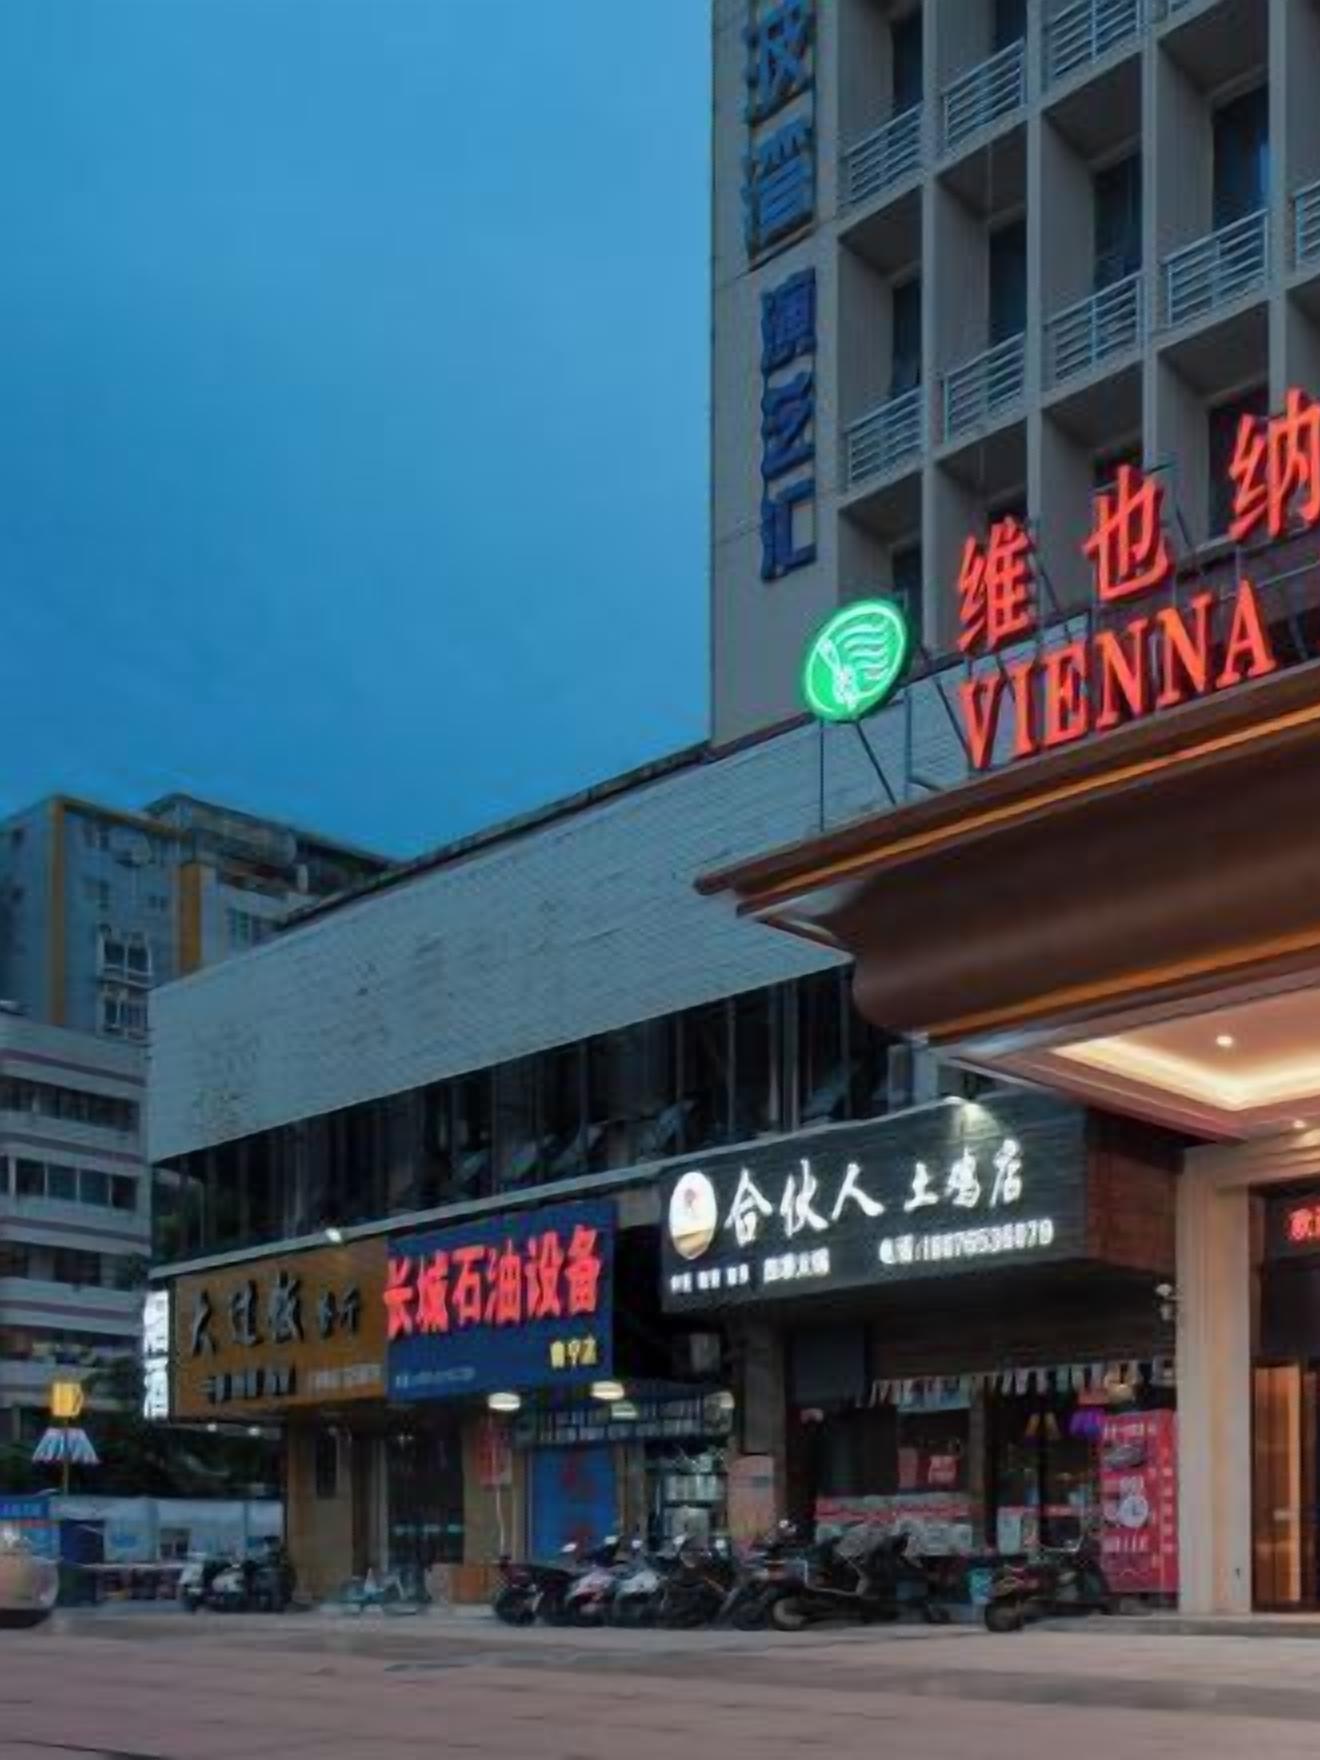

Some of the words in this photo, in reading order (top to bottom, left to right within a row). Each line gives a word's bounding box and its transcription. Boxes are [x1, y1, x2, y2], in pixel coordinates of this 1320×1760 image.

[957, 580, 1275, 770] VIENNA
[724, 1159, 885, 1248] 合伙人
